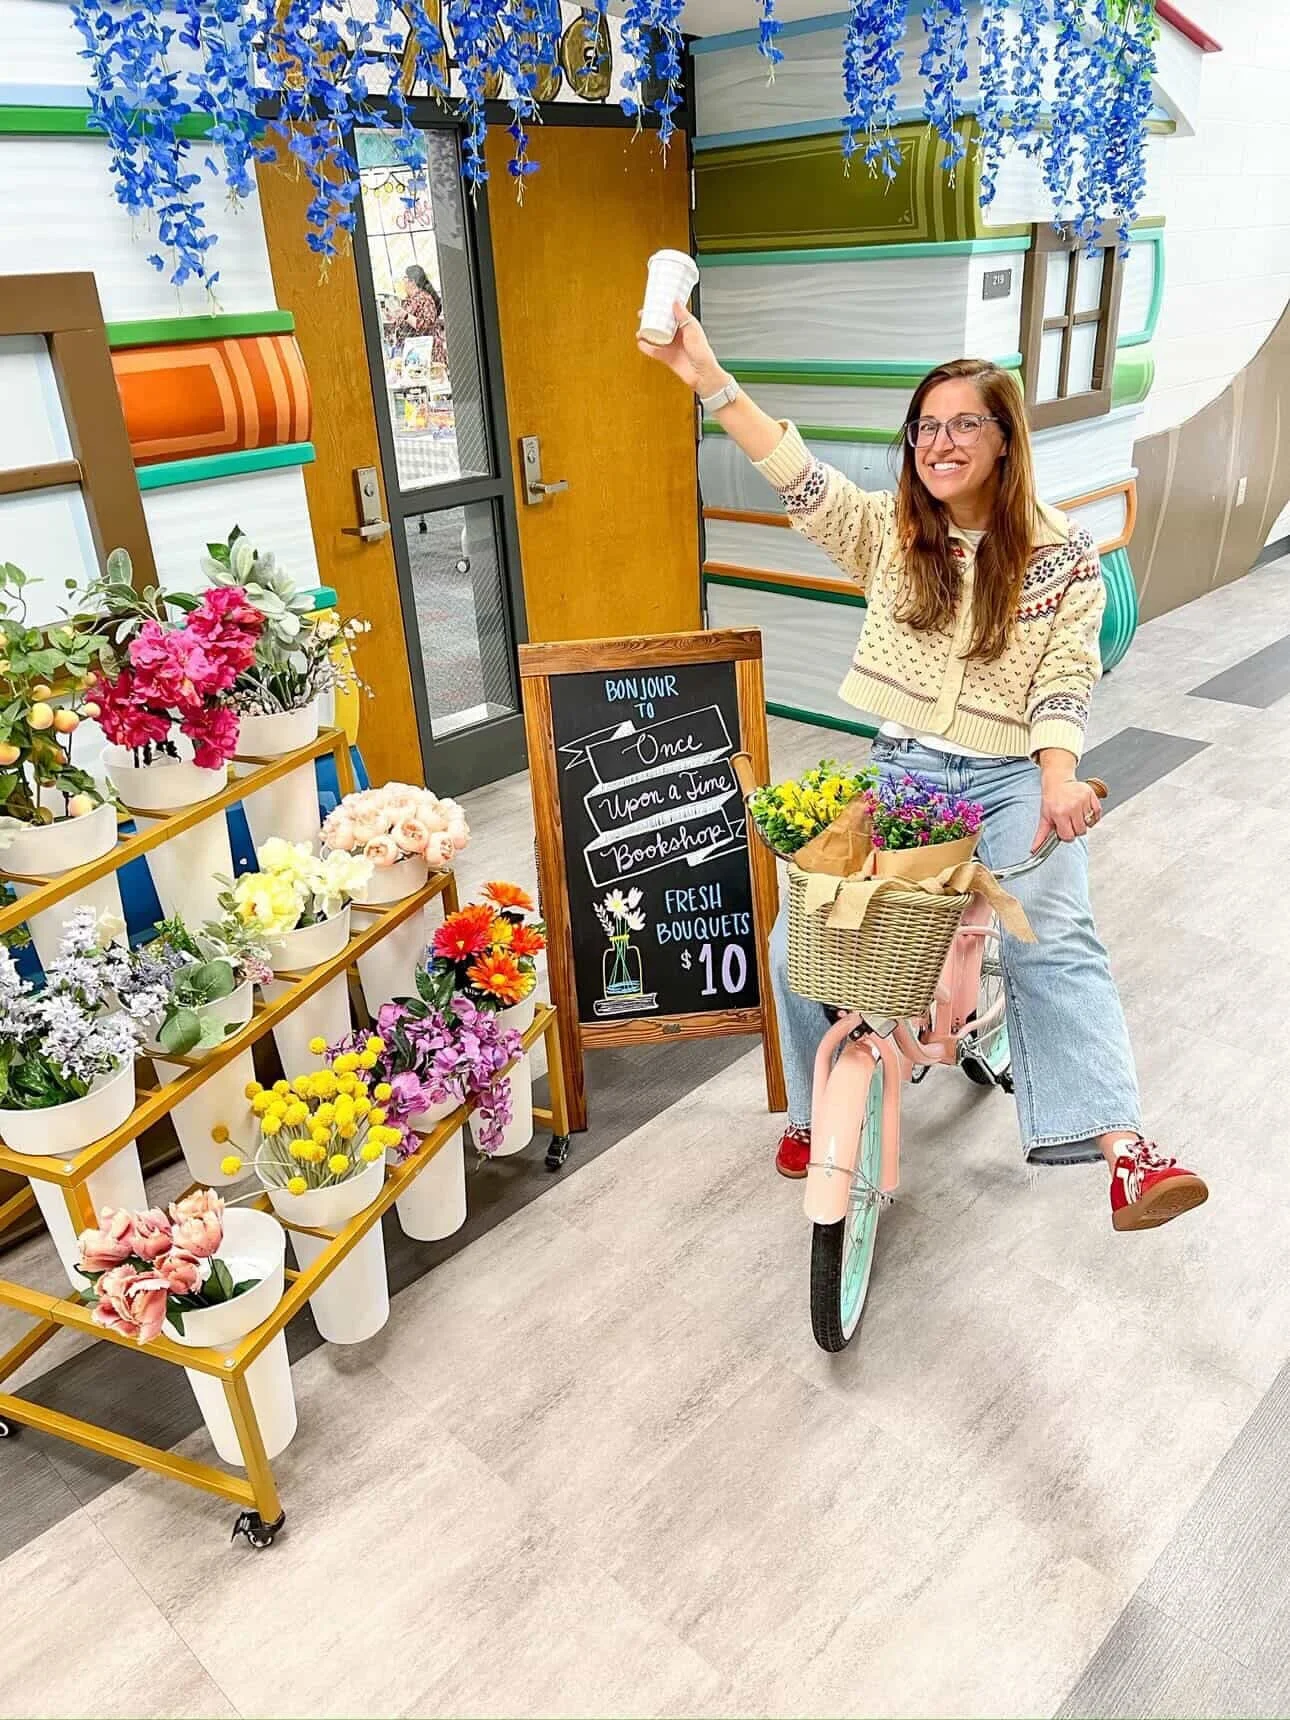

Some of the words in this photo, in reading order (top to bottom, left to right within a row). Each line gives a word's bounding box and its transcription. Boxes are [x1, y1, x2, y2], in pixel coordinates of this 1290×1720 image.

[992, 273, 1005, 286] 219
[605, 675, 679, 701] BONJOUR
[634, 702, 655, 719] TO
[621, 732, 703, 764] Once
[599, 791, 665, 822] Upon
[668, 784, 682, 801] a
[679, 770, 731, 801] Time
[600, 824, 726, 873] Bookshop
[665, 882, 723, 914] FRESH
[656, 912, 750, 945] BOUQUETS
